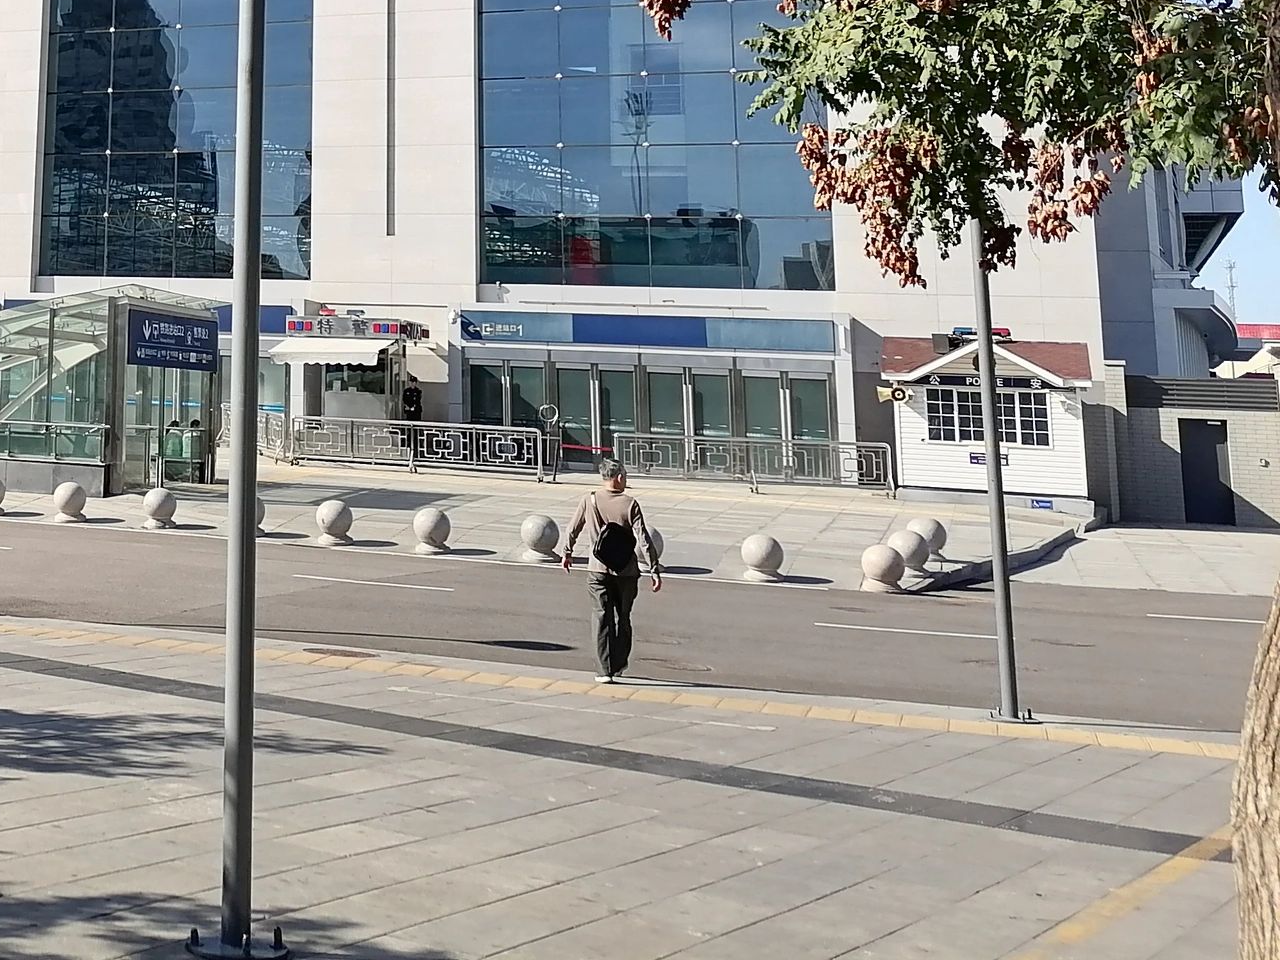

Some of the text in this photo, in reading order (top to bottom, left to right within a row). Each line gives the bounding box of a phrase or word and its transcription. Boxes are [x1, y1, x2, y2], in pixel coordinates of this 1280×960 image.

[929, 375, 1042, 389] 公 POE 安
